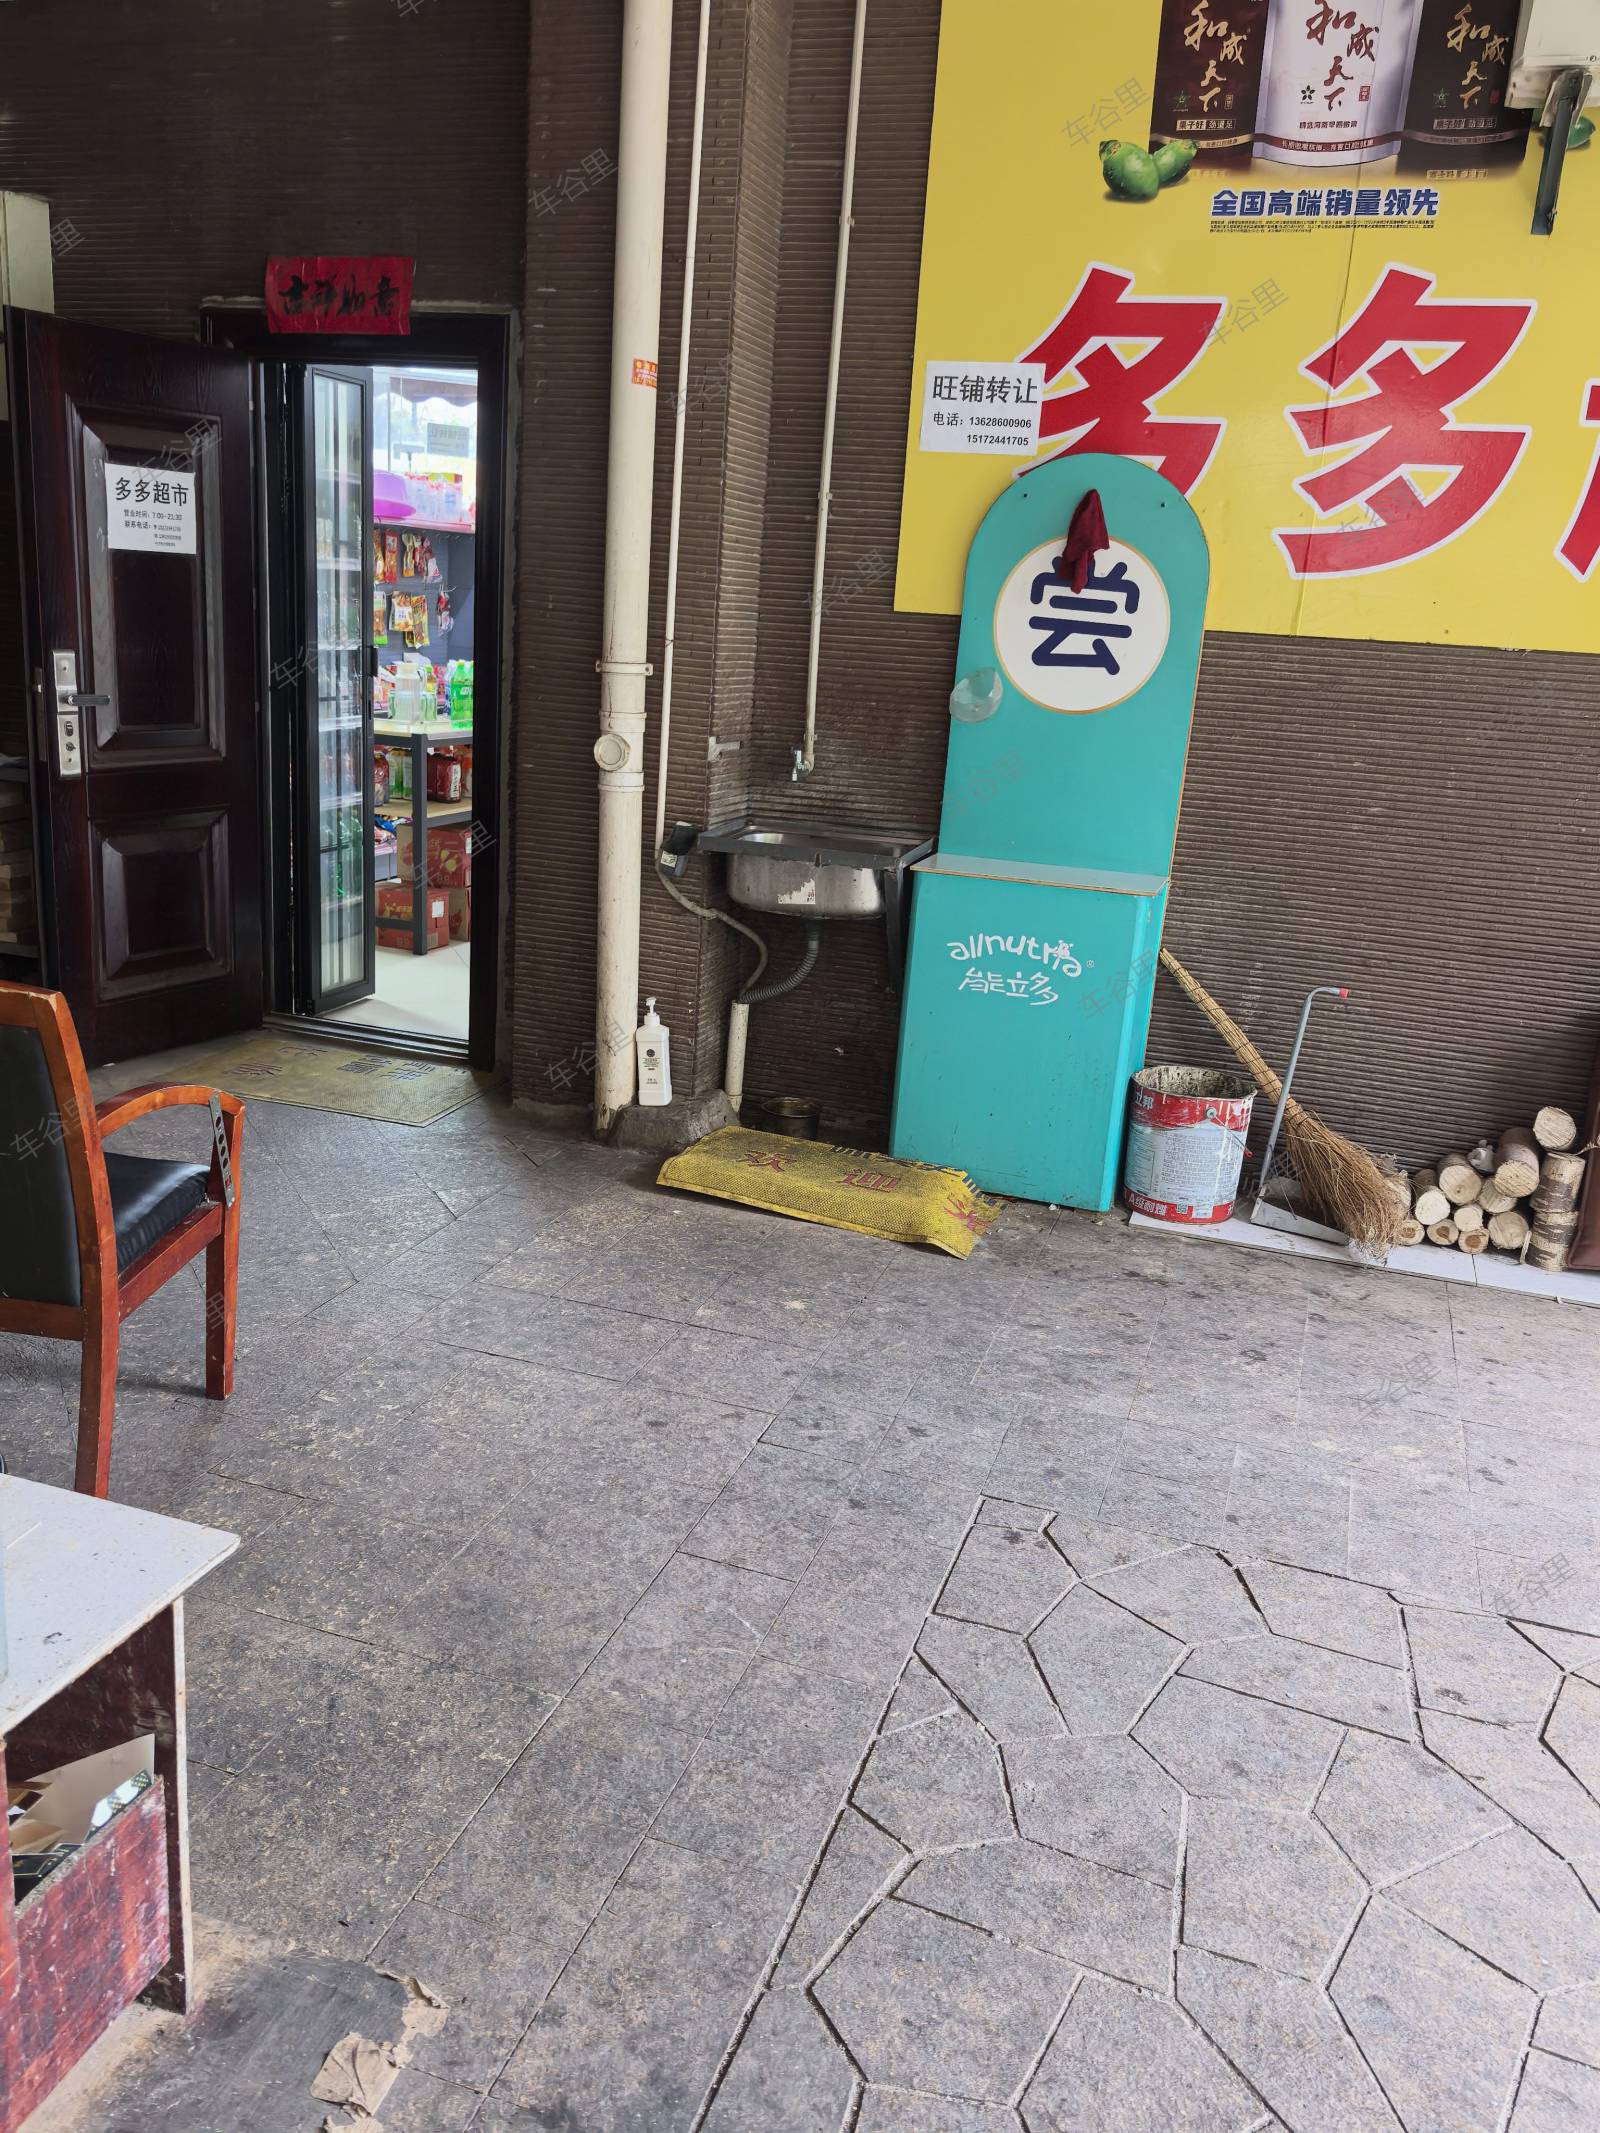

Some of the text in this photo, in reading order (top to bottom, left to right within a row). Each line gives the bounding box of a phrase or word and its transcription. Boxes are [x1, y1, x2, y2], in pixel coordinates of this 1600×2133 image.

[1211, 188, 1439, 217] 全国高端销量领先
[932, 375, 1038, 404] 旺铺转让
[966, 434, 1030, 446] 15172441705
[115, 477, 189, 507] 多多超市
[957, 966, 1059, 1006] 能立多
